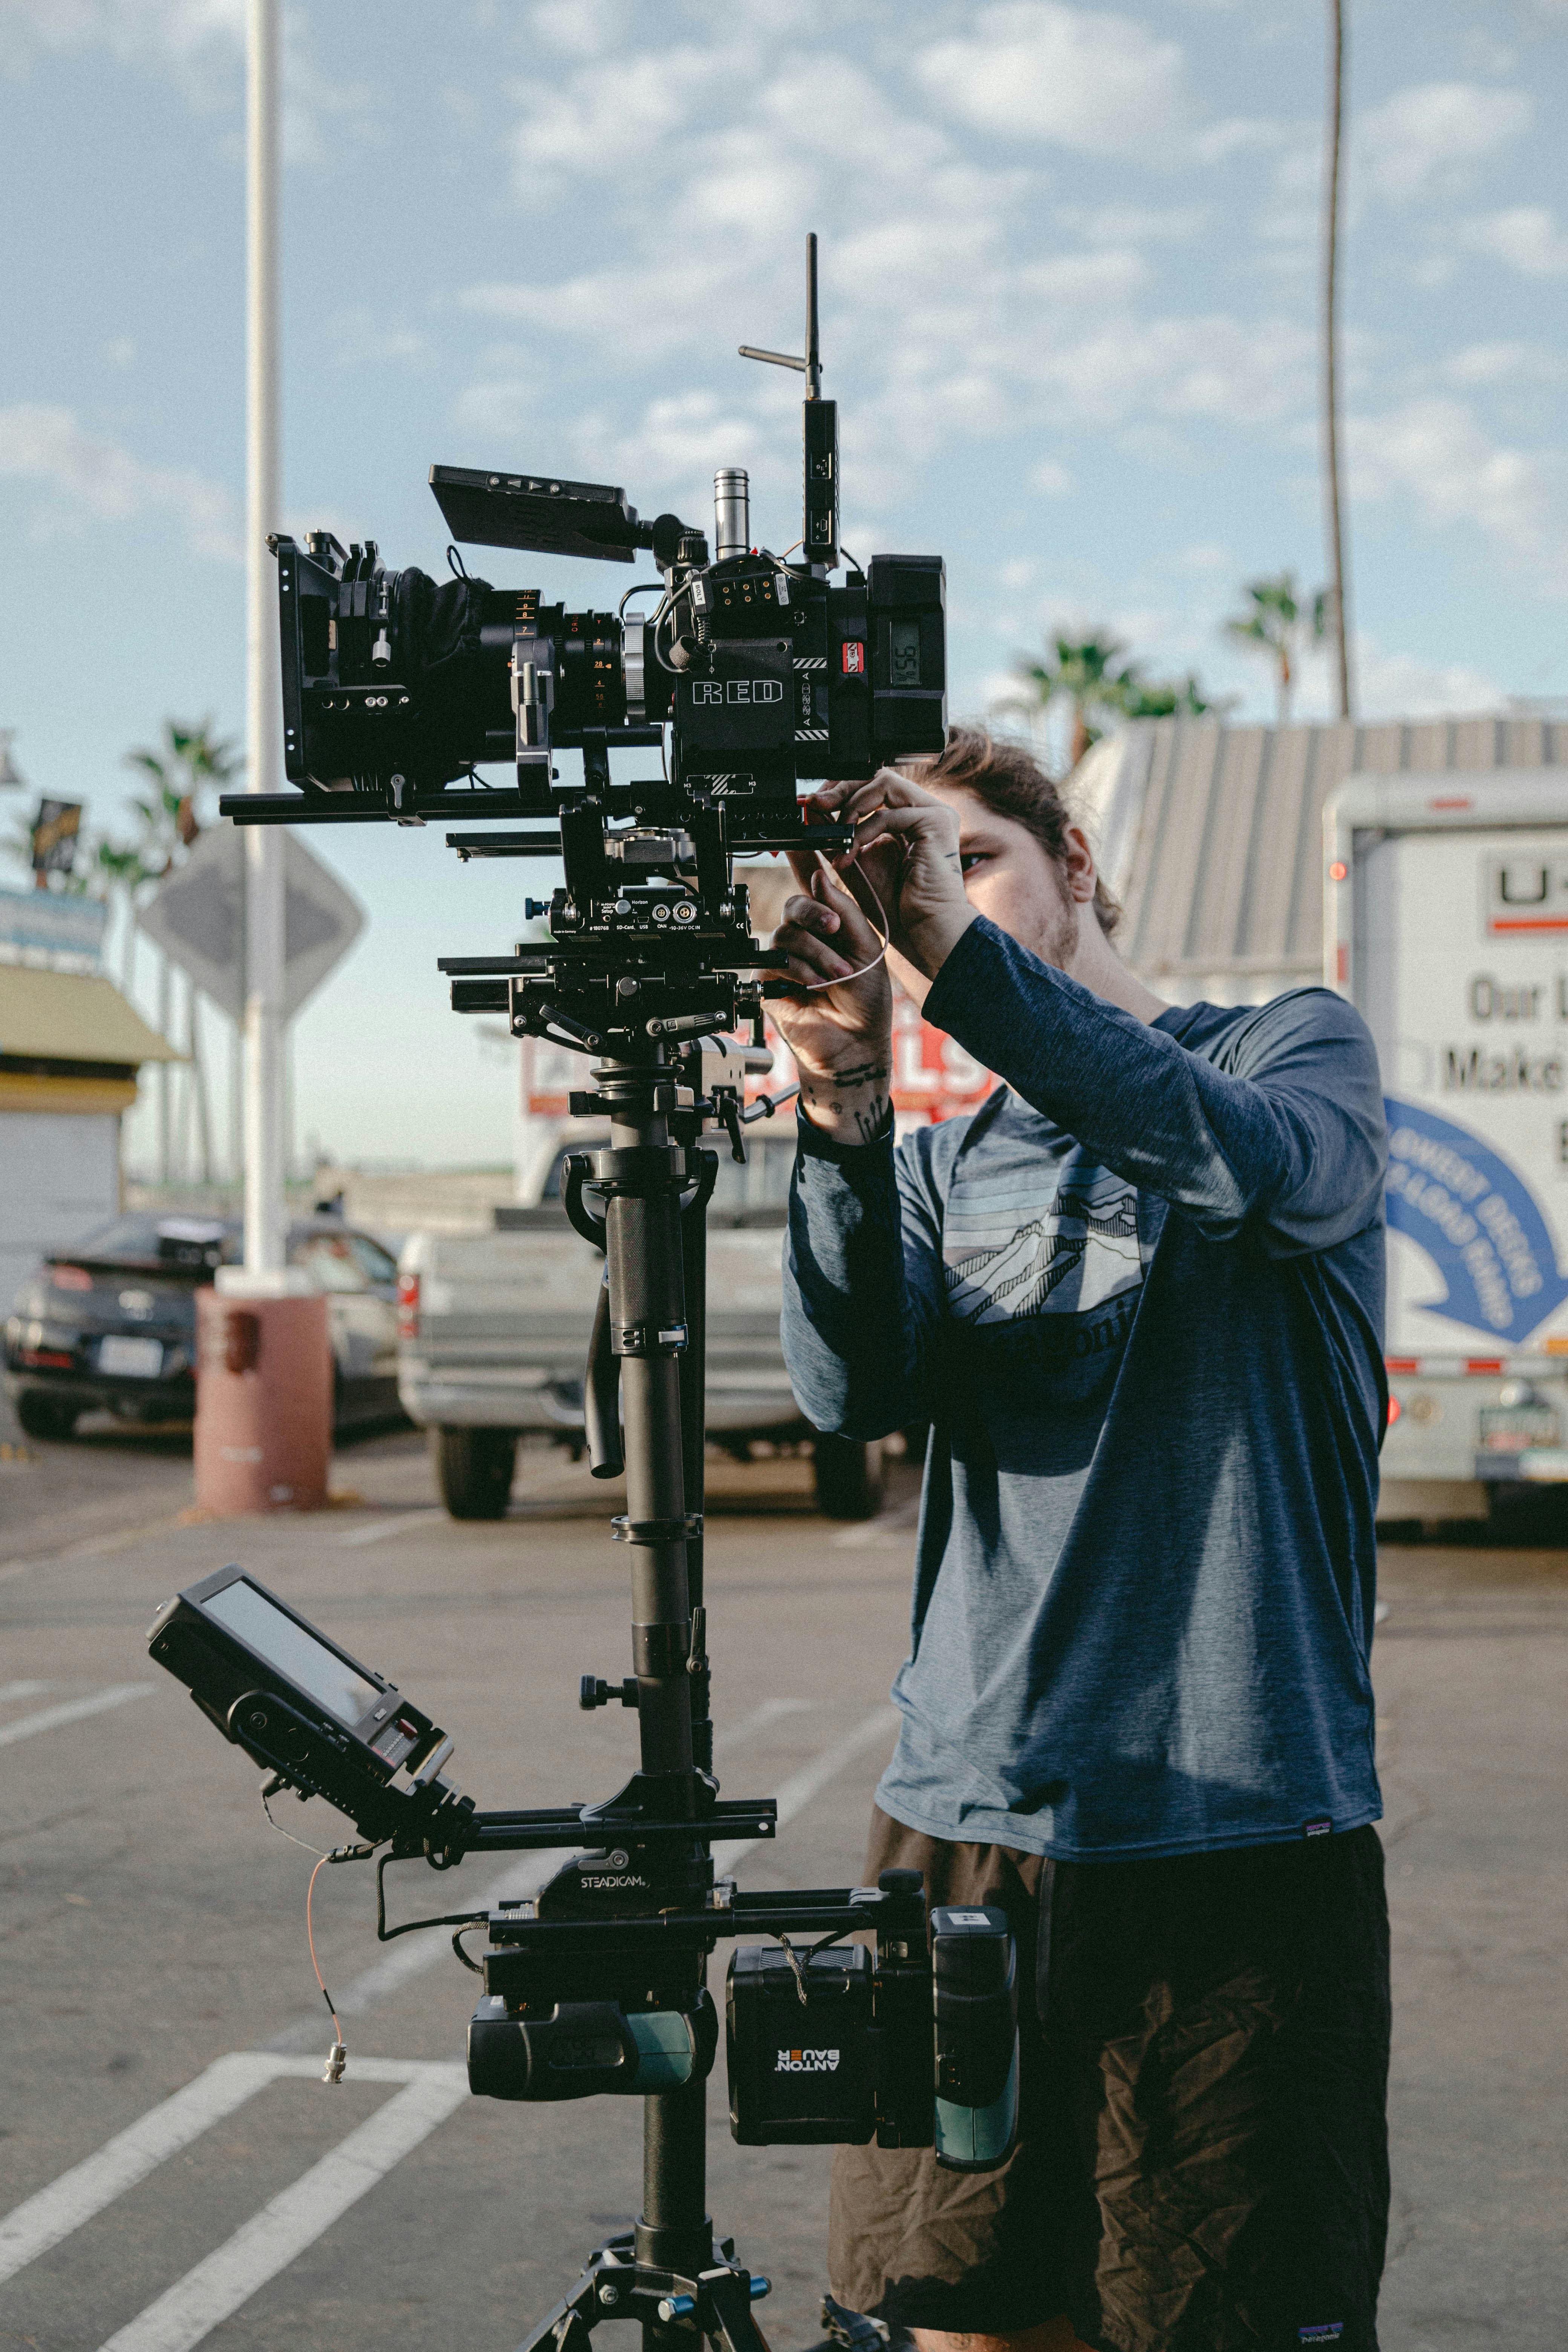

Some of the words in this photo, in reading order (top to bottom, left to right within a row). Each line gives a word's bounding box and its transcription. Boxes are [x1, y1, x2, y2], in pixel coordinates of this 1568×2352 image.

[692, 680, 783, 704] RED
[1472, 978, 1542, 1018] Our
[778, 2050, 840, 2060] BAUER
[778, 2060, 840, 2071] ANTON
